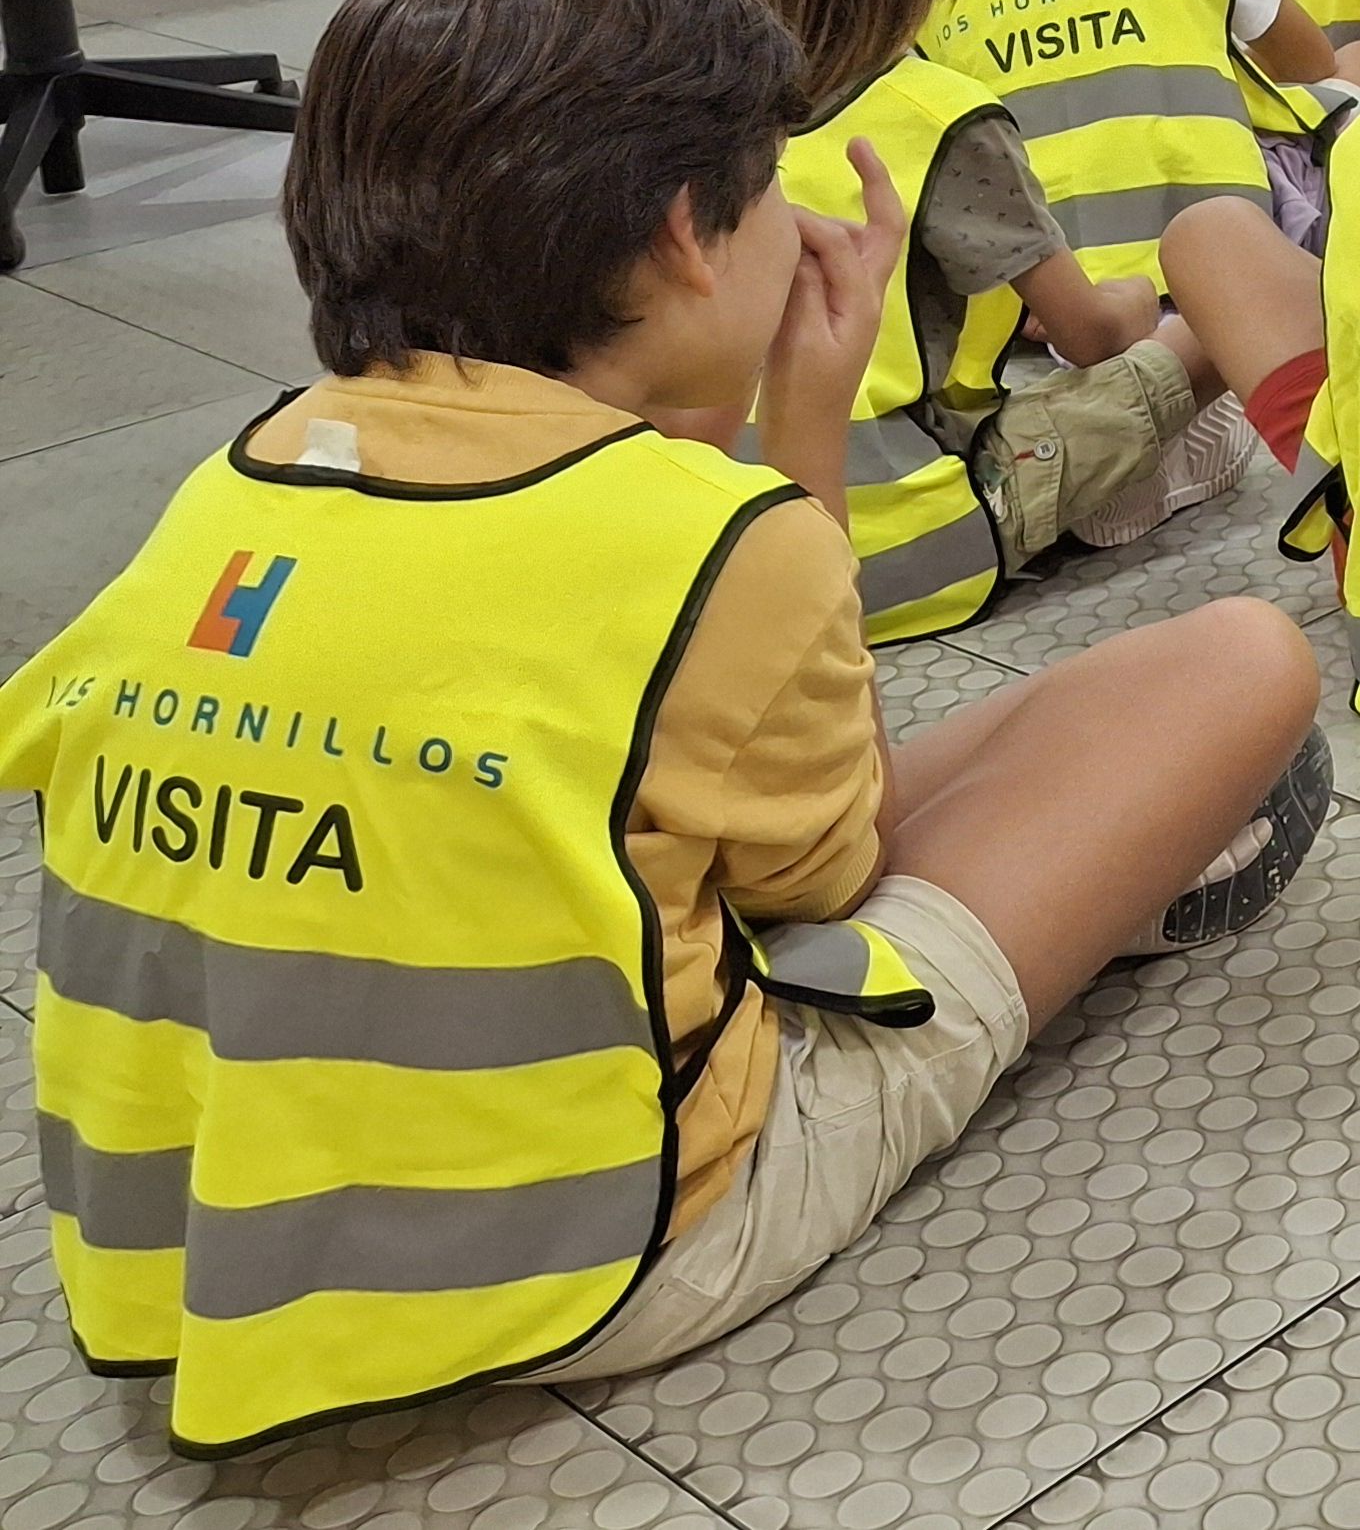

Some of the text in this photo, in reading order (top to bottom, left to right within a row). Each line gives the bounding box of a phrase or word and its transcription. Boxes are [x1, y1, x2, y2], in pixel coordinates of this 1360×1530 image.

[985, 8, 1146, 73] VISITA
[114, 678, 508, 788] HORNILLOS
[94, 754, 363, 893] VISITA
